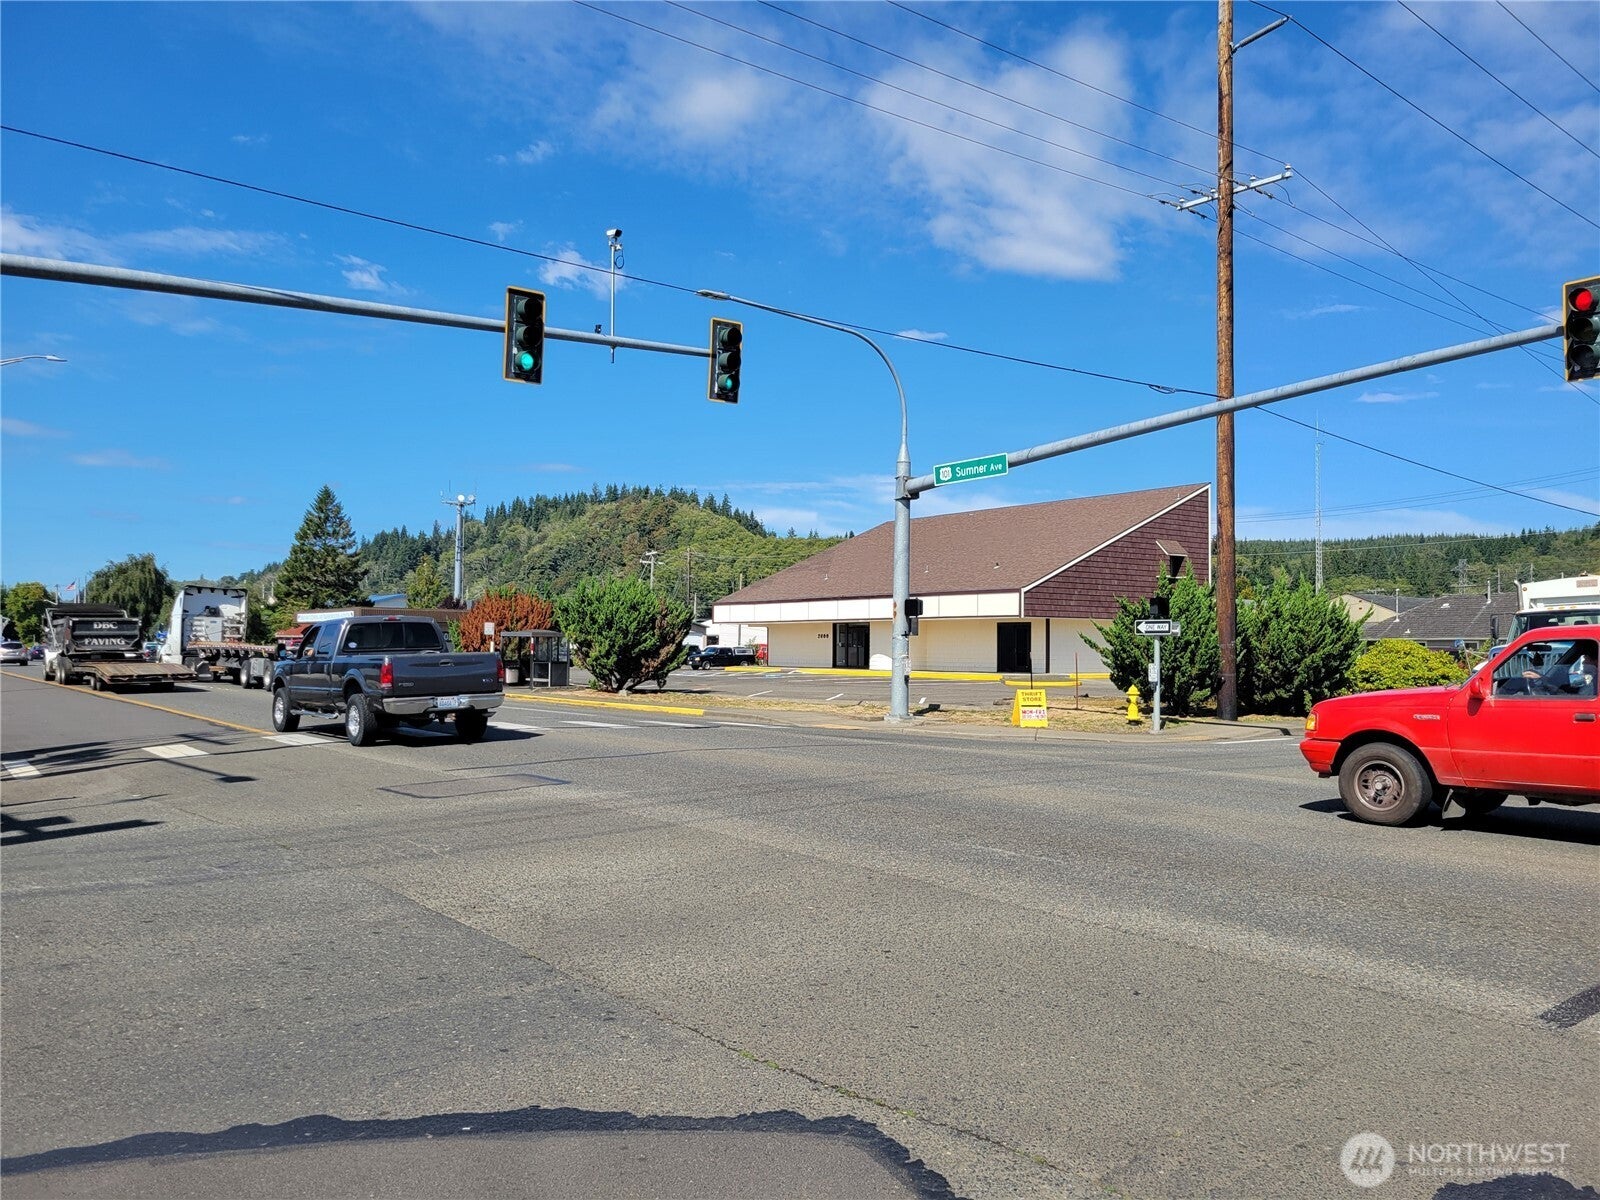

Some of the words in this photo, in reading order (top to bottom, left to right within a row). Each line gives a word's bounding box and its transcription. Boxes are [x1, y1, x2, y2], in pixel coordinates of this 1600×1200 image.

[941, 470, 951, 478] 101
[955, 464, 987, 477] Sumner
[990, 463, 1002, 471] Ave
[93, 621, 118, 629] DBC
[84, 637, 125, 646] PAVING
